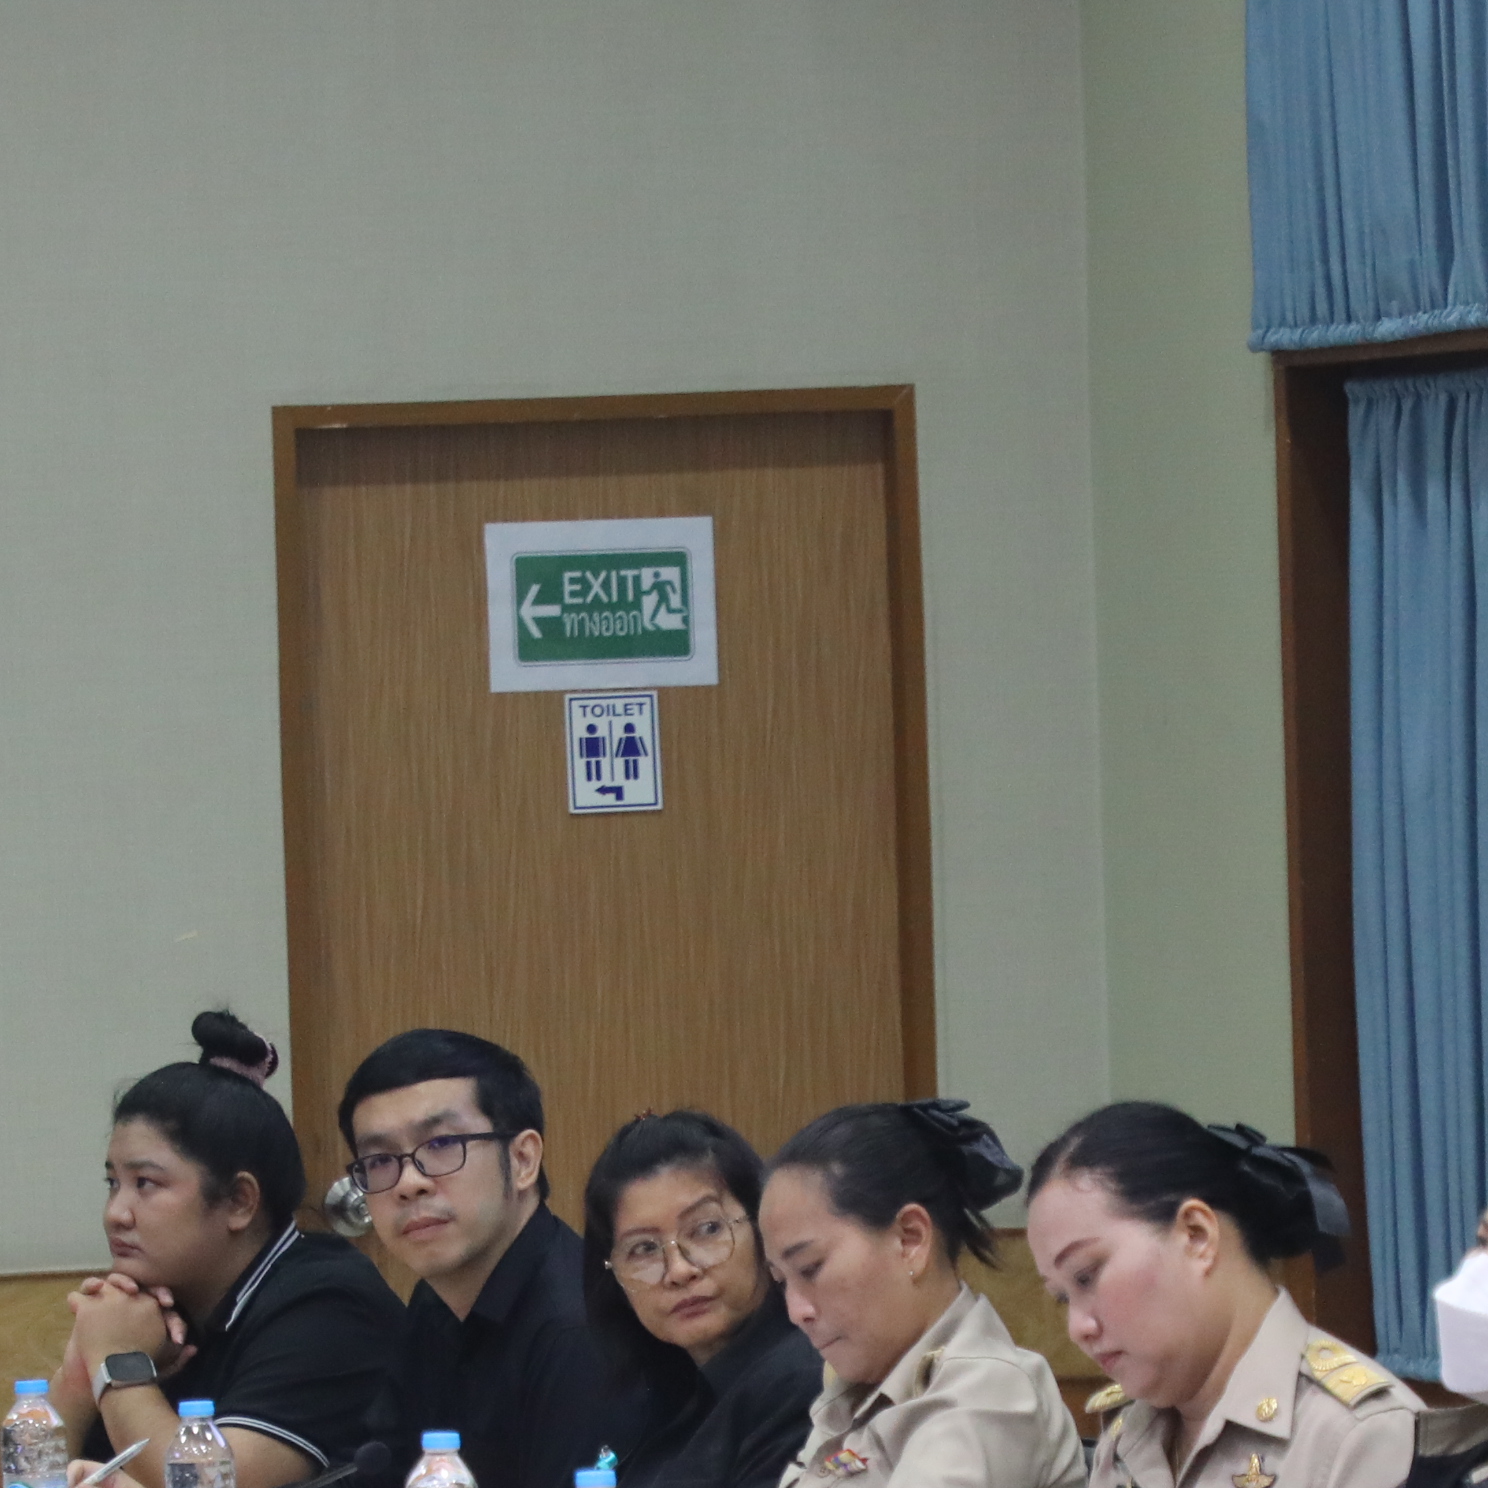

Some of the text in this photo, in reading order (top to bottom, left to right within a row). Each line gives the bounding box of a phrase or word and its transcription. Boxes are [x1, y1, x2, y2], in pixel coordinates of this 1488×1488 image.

[563, 569, 641, 604] EXIT
[562, 610, 642, 638] ทางออก
[578, 702, 647, 718] TOILET
